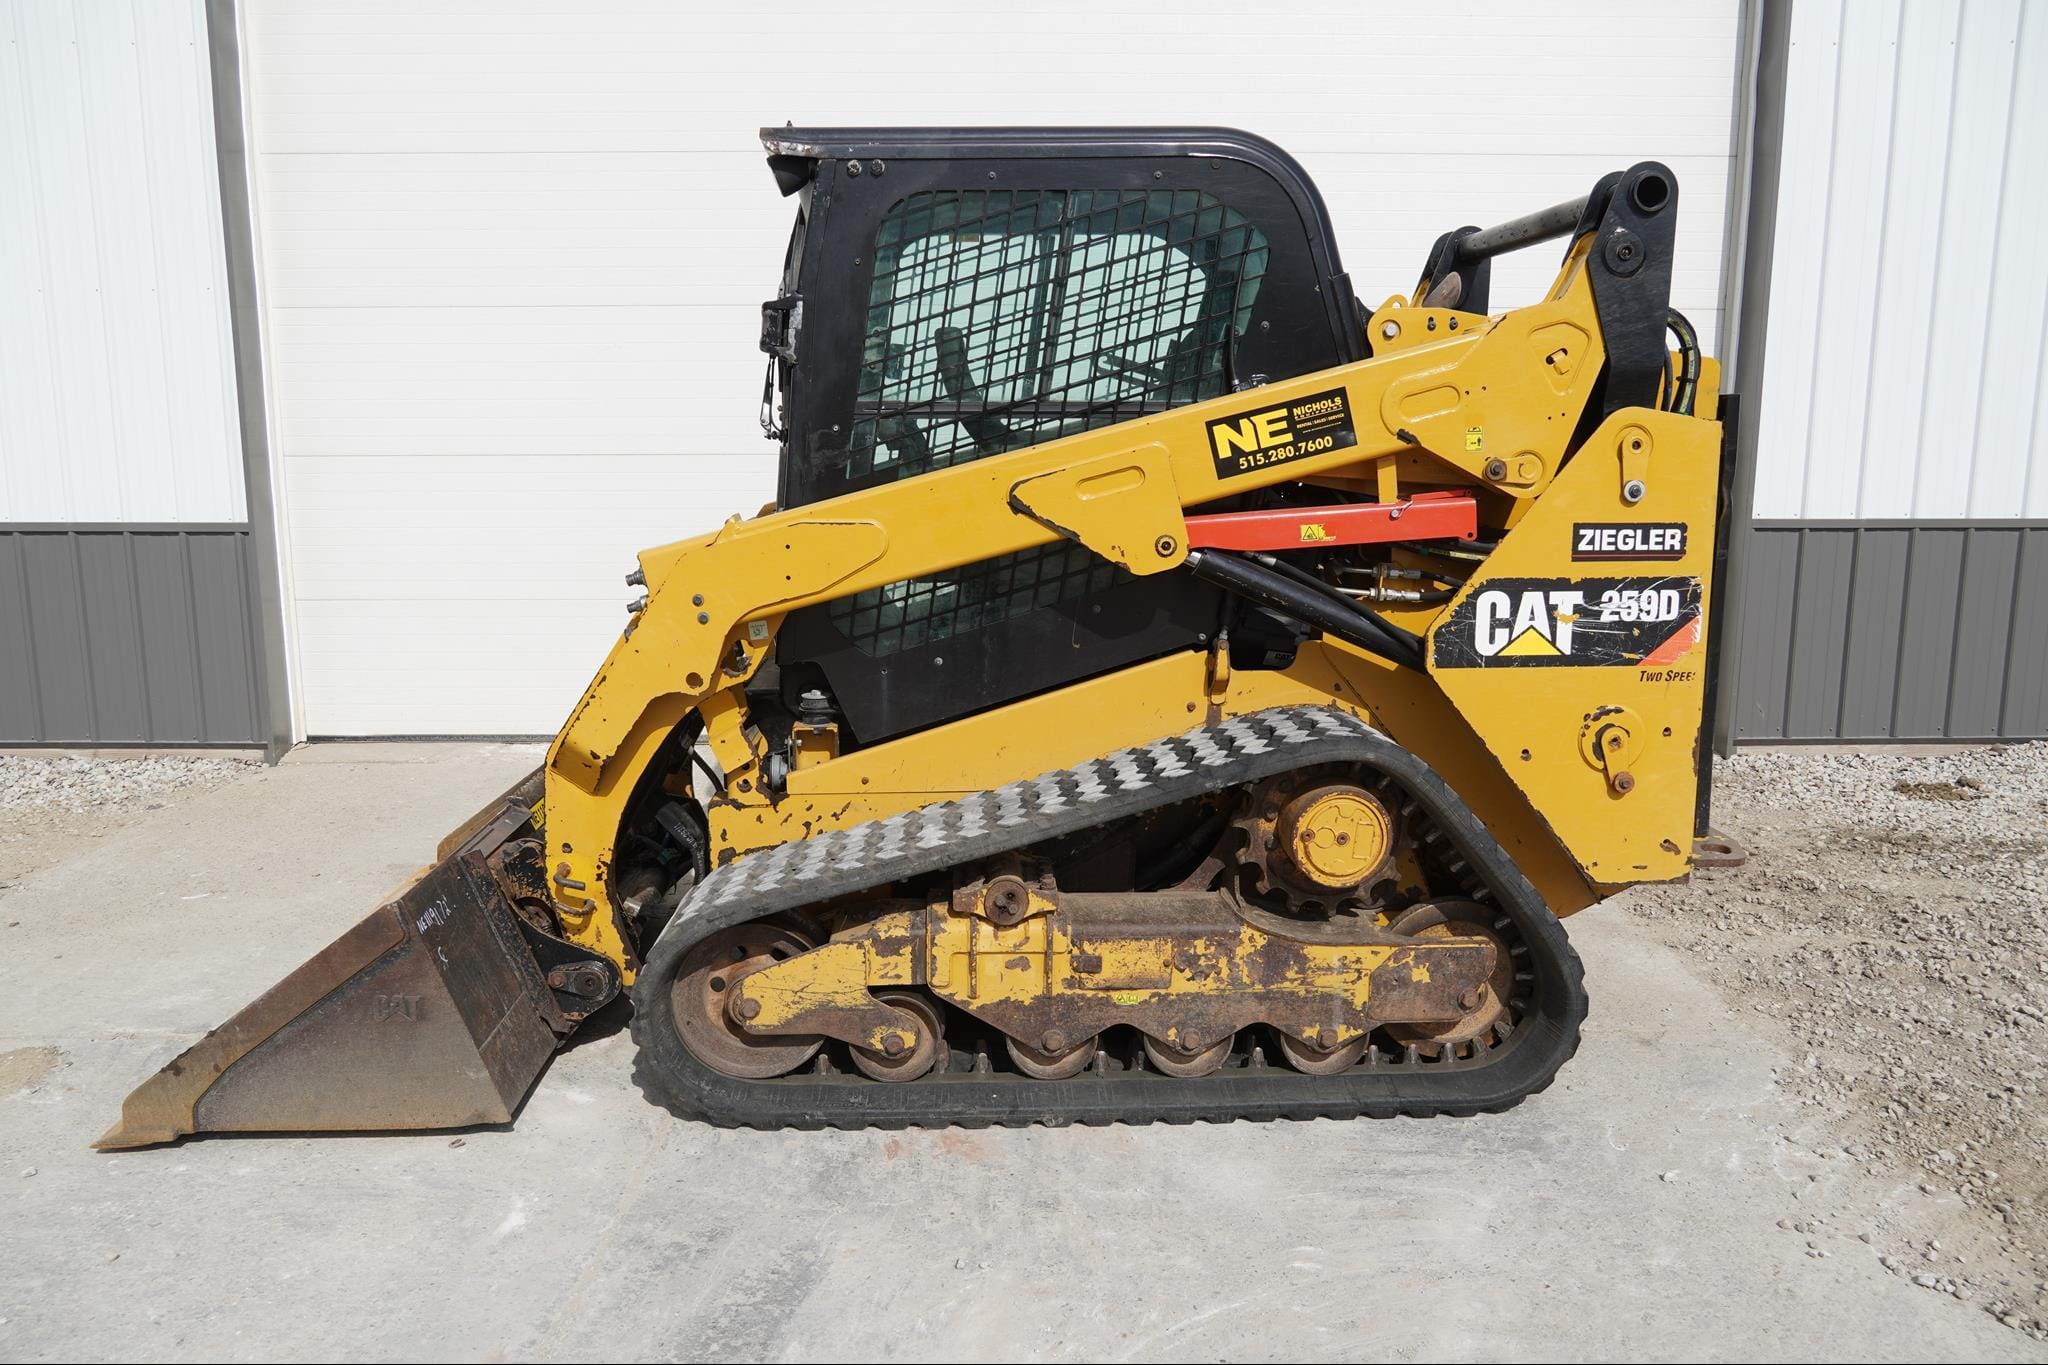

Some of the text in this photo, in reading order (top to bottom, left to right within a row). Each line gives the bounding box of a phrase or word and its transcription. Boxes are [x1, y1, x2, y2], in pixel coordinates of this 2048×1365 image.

[1293, 397, 1342, 416] NICHOLS
[1212, 408, 1294, 460] NE
[1239, 436, 1333, 470] 515.280.7600
[1577, 528, 1682, 551] ZIEGLER
[1474, 590, 1680, 656] CAT 259D
[1665, 670, 1696, 682] SPEE
